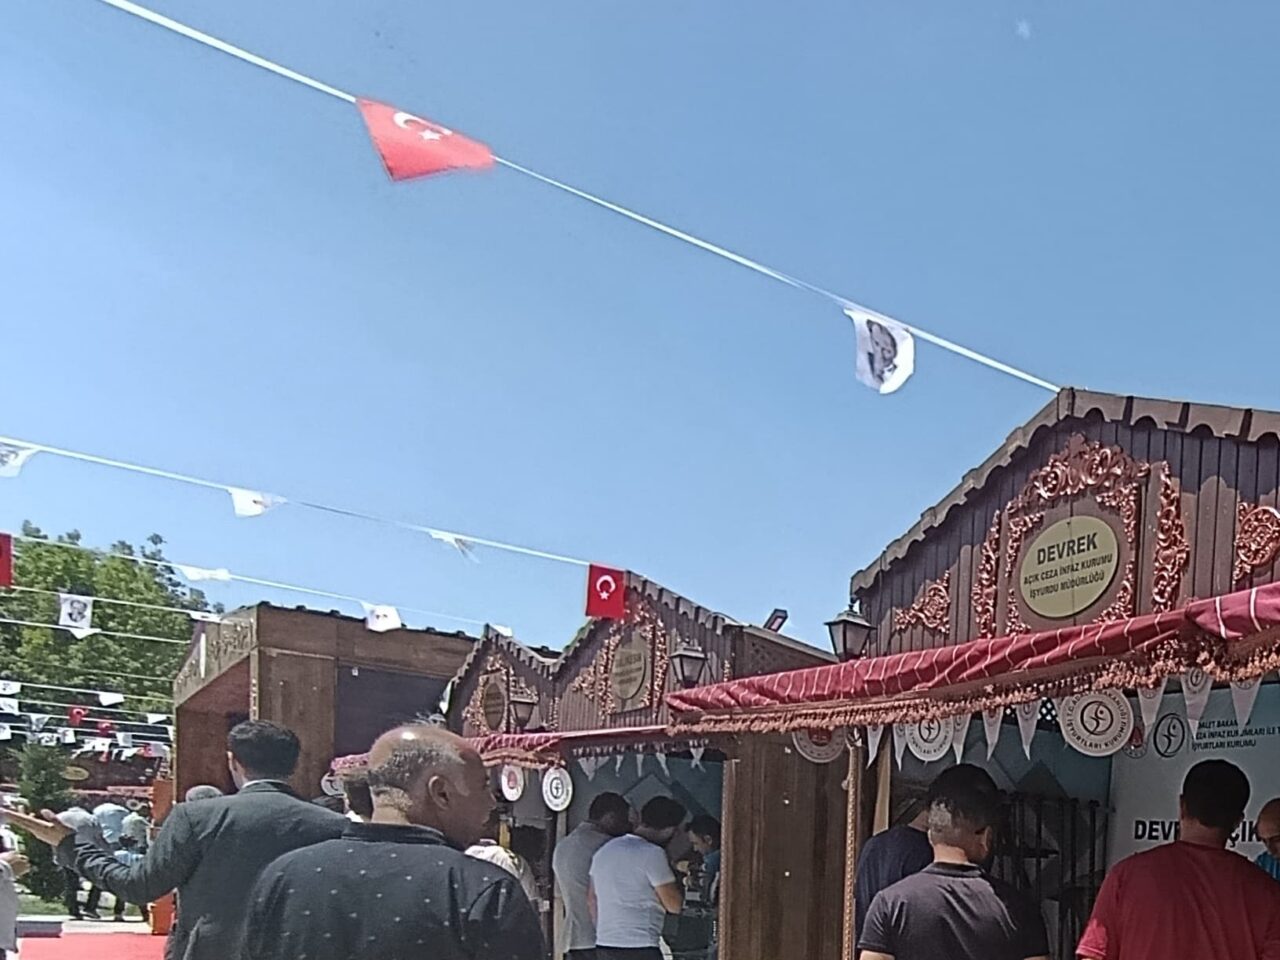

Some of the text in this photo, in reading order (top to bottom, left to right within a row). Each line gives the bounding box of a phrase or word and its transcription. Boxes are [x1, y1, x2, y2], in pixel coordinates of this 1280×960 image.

[1037, 532, 1097, 565] DEVREK
[1024, 553, 1113, 585] AÇIK CEZA İNFAZ KURUMU
